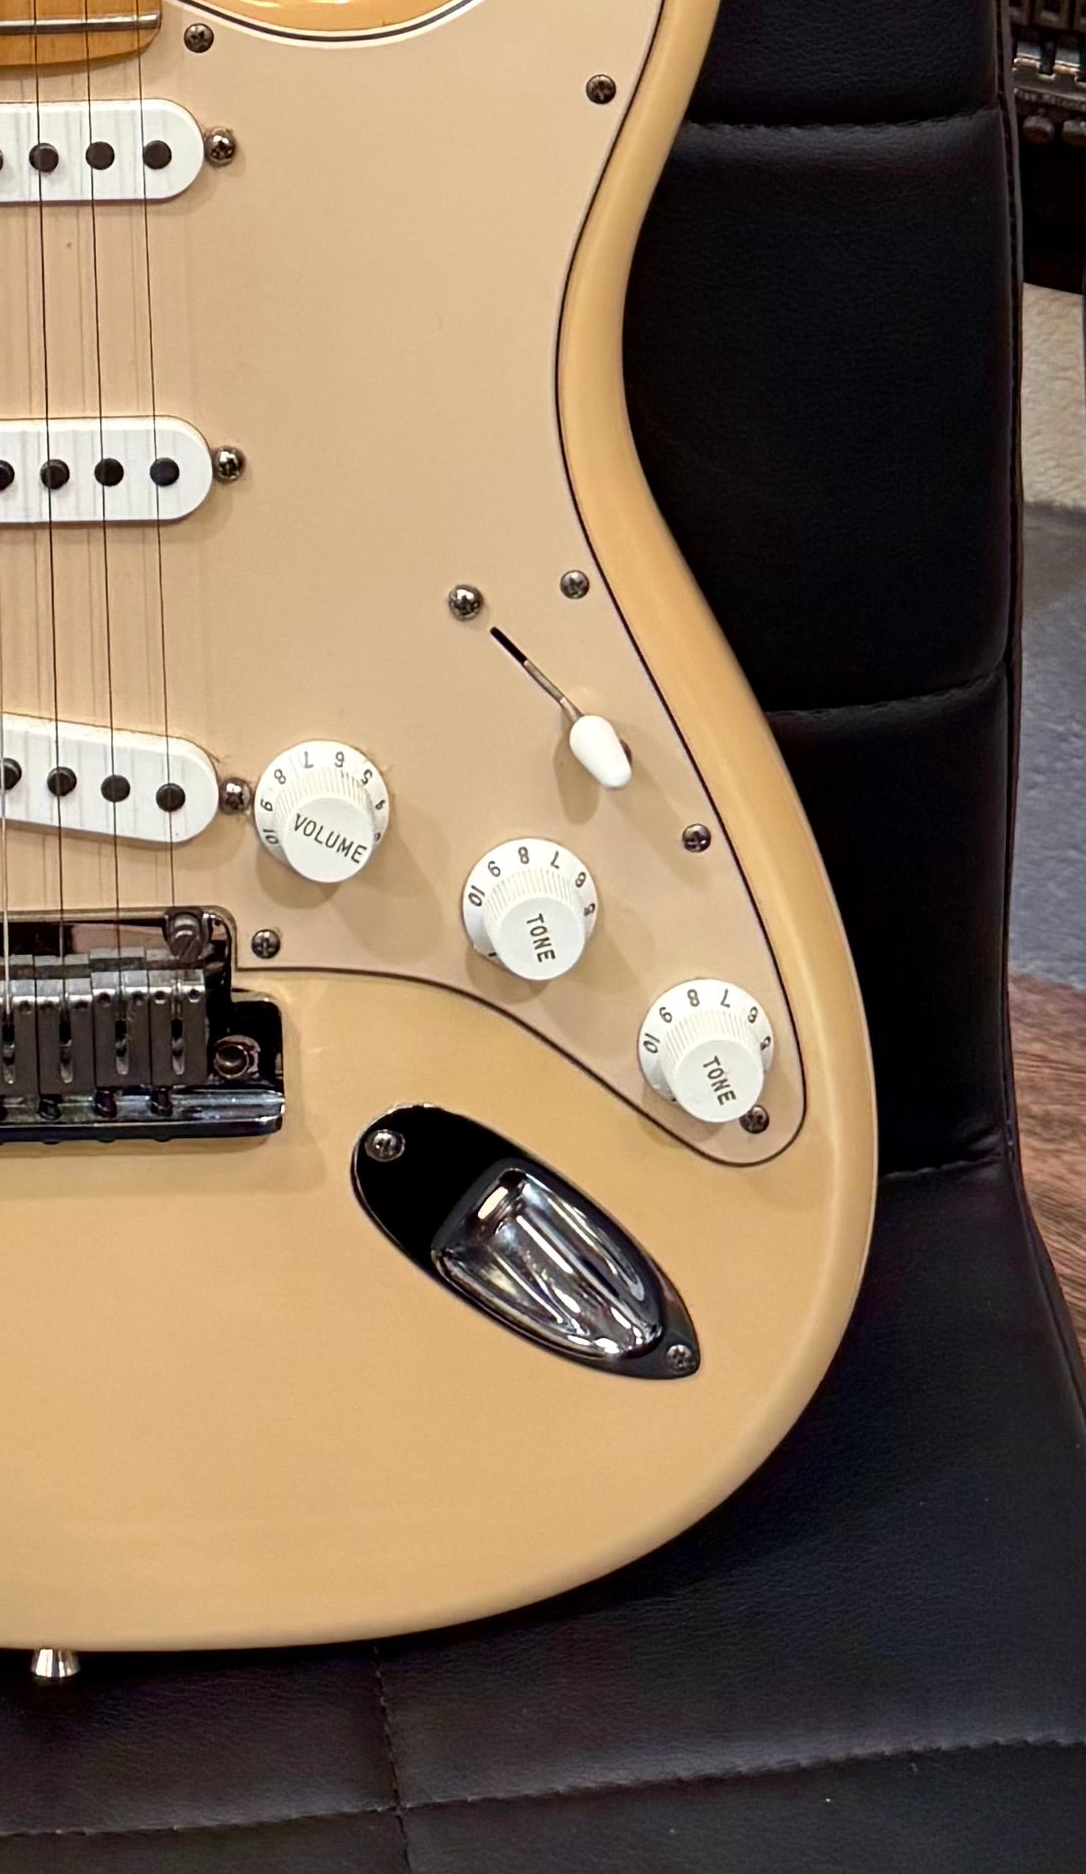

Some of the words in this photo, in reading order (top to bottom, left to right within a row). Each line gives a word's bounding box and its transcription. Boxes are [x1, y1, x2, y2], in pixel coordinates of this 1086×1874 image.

[273, 768, 287, 785] 8
[303, 751, 314, 769] 7
[294, 812, 367, 864] VOLUME
[517, 846, 530, 865] 8
[550, 850, 560, 869] 7
[526, 912, 556, 963] TONE
[687, 988, 700, 1007] 8
[720, 988, 731, 1008] 7
[703, 1055, 737, 1106] TONE
